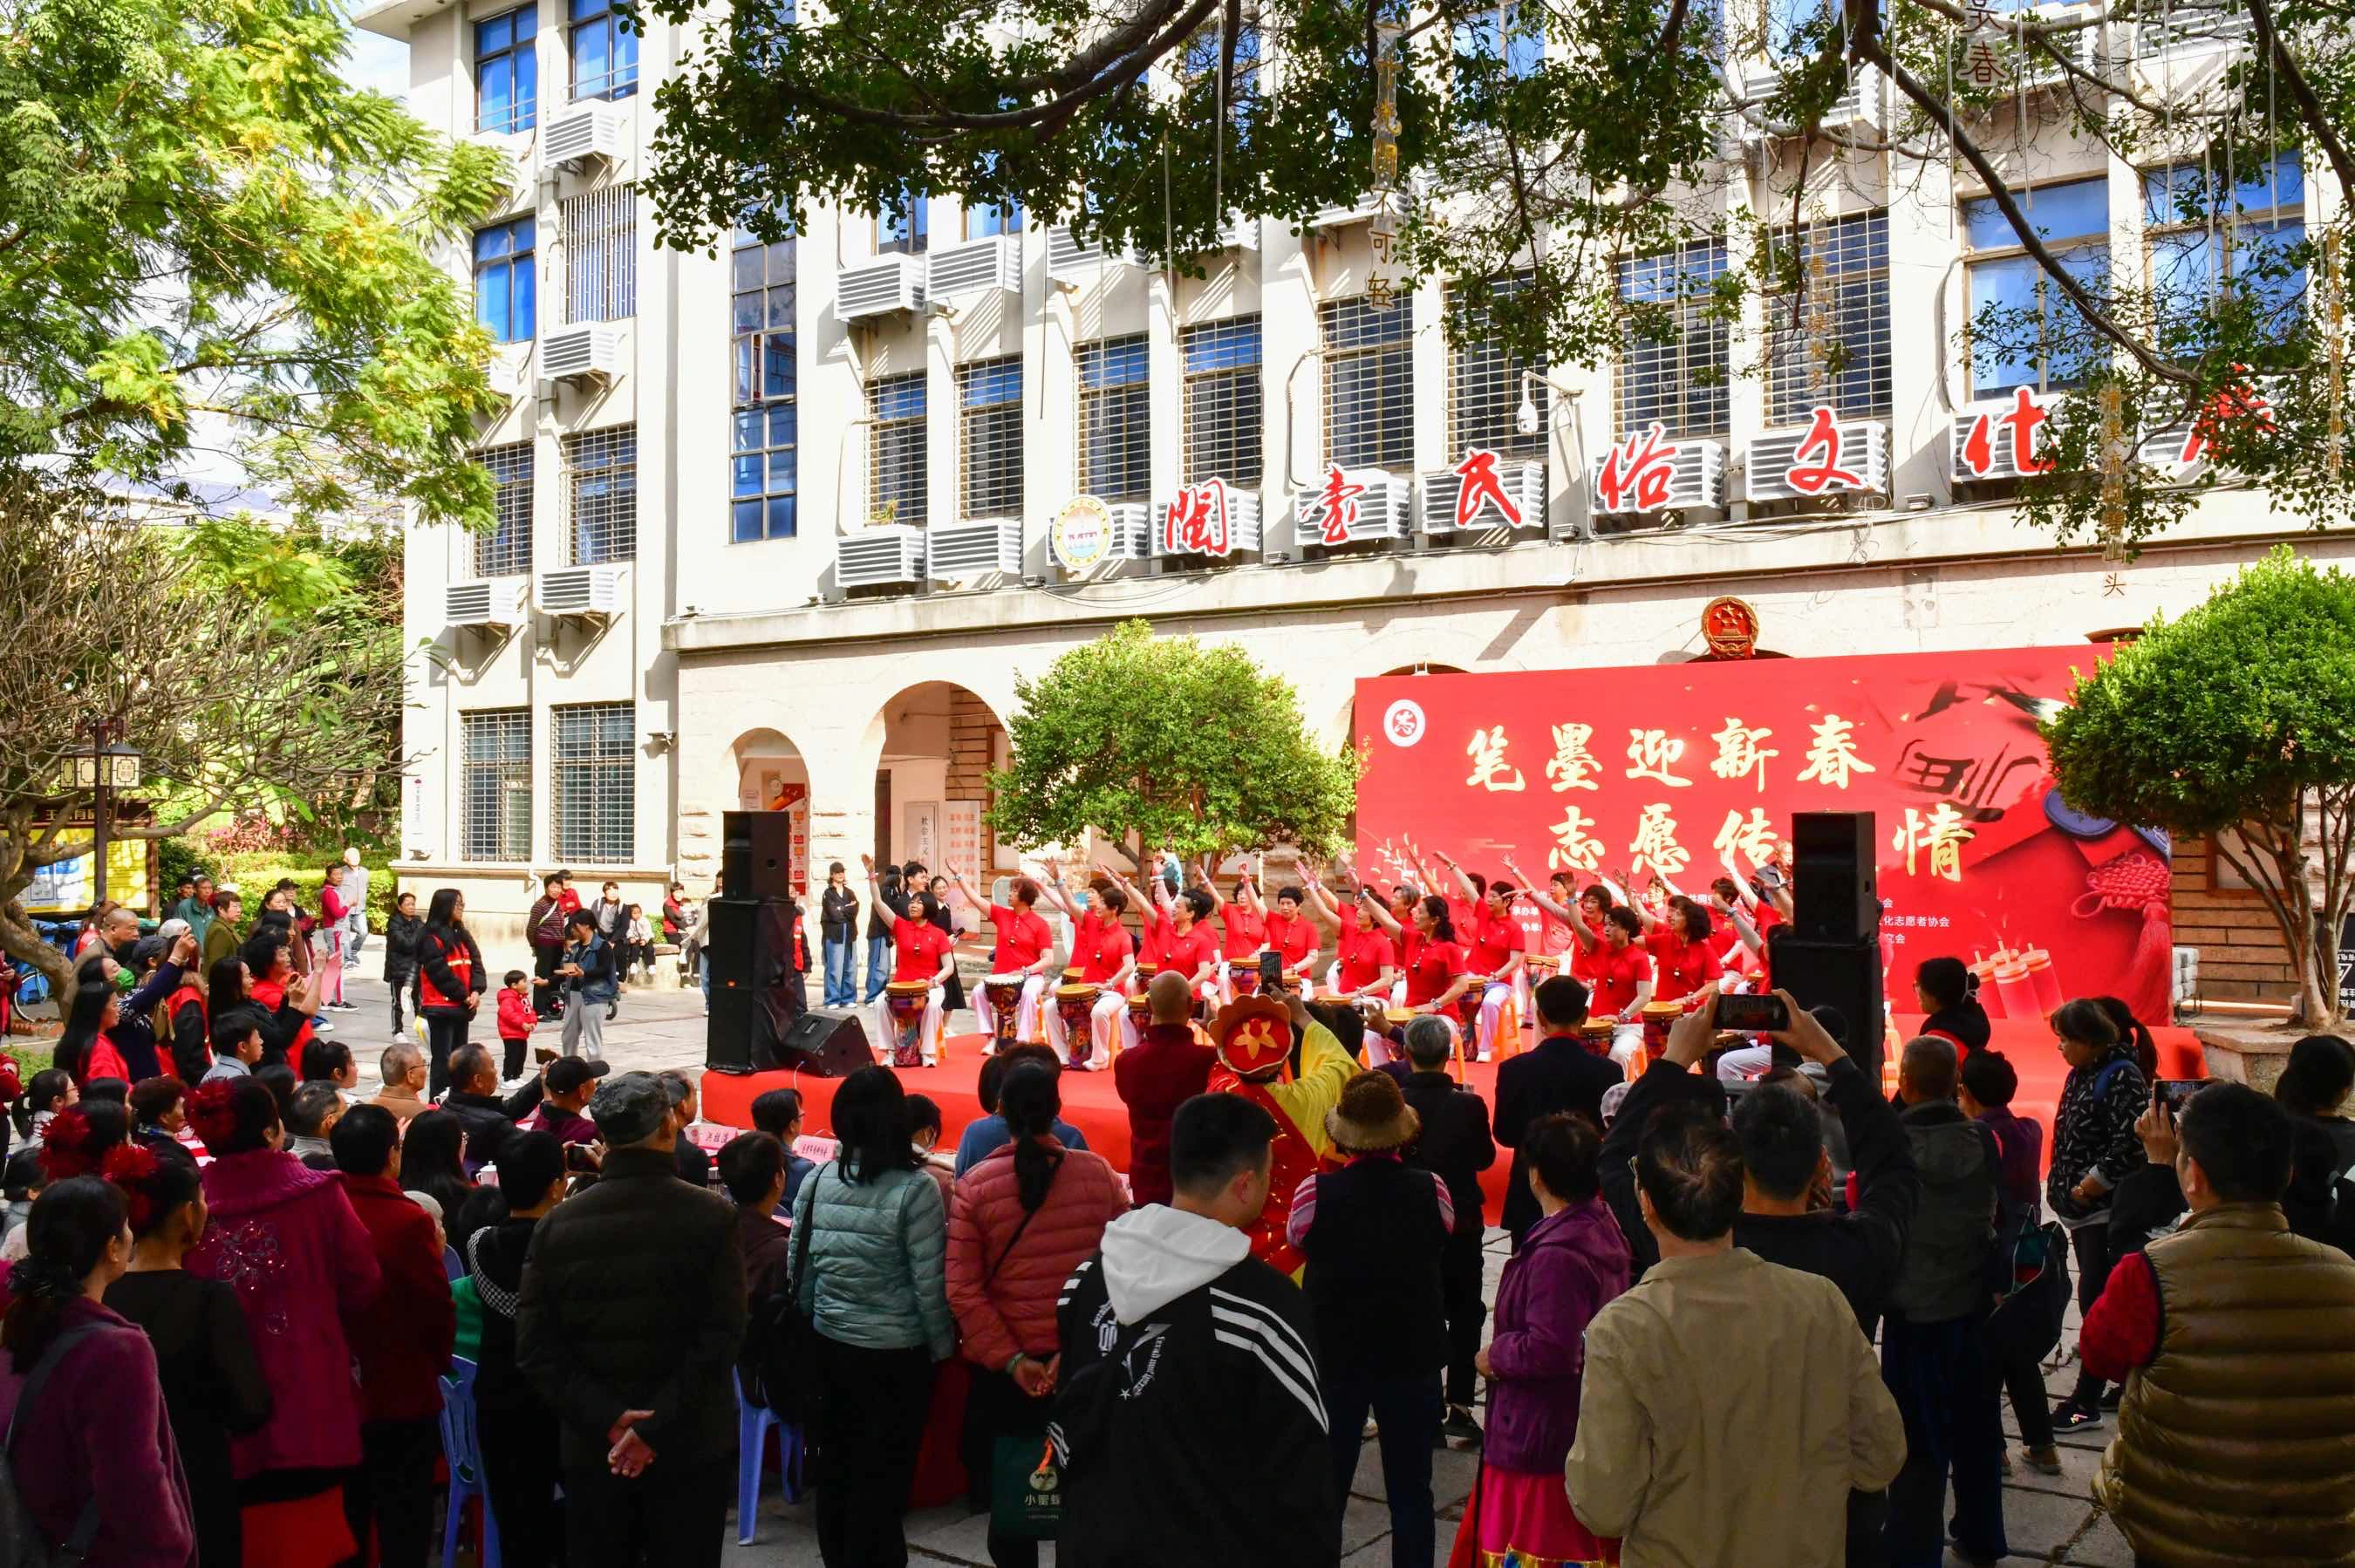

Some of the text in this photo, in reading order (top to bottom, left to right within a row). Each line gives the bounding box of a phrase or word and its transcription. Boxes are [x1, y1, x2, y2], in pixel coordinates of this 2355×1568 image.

[1465, 713, 1877, 793] 笔墨迎新春
[1548, 802, 1976, 883] 志愿传情
[1879, 916, 1950, 928] 化志愿者协会
